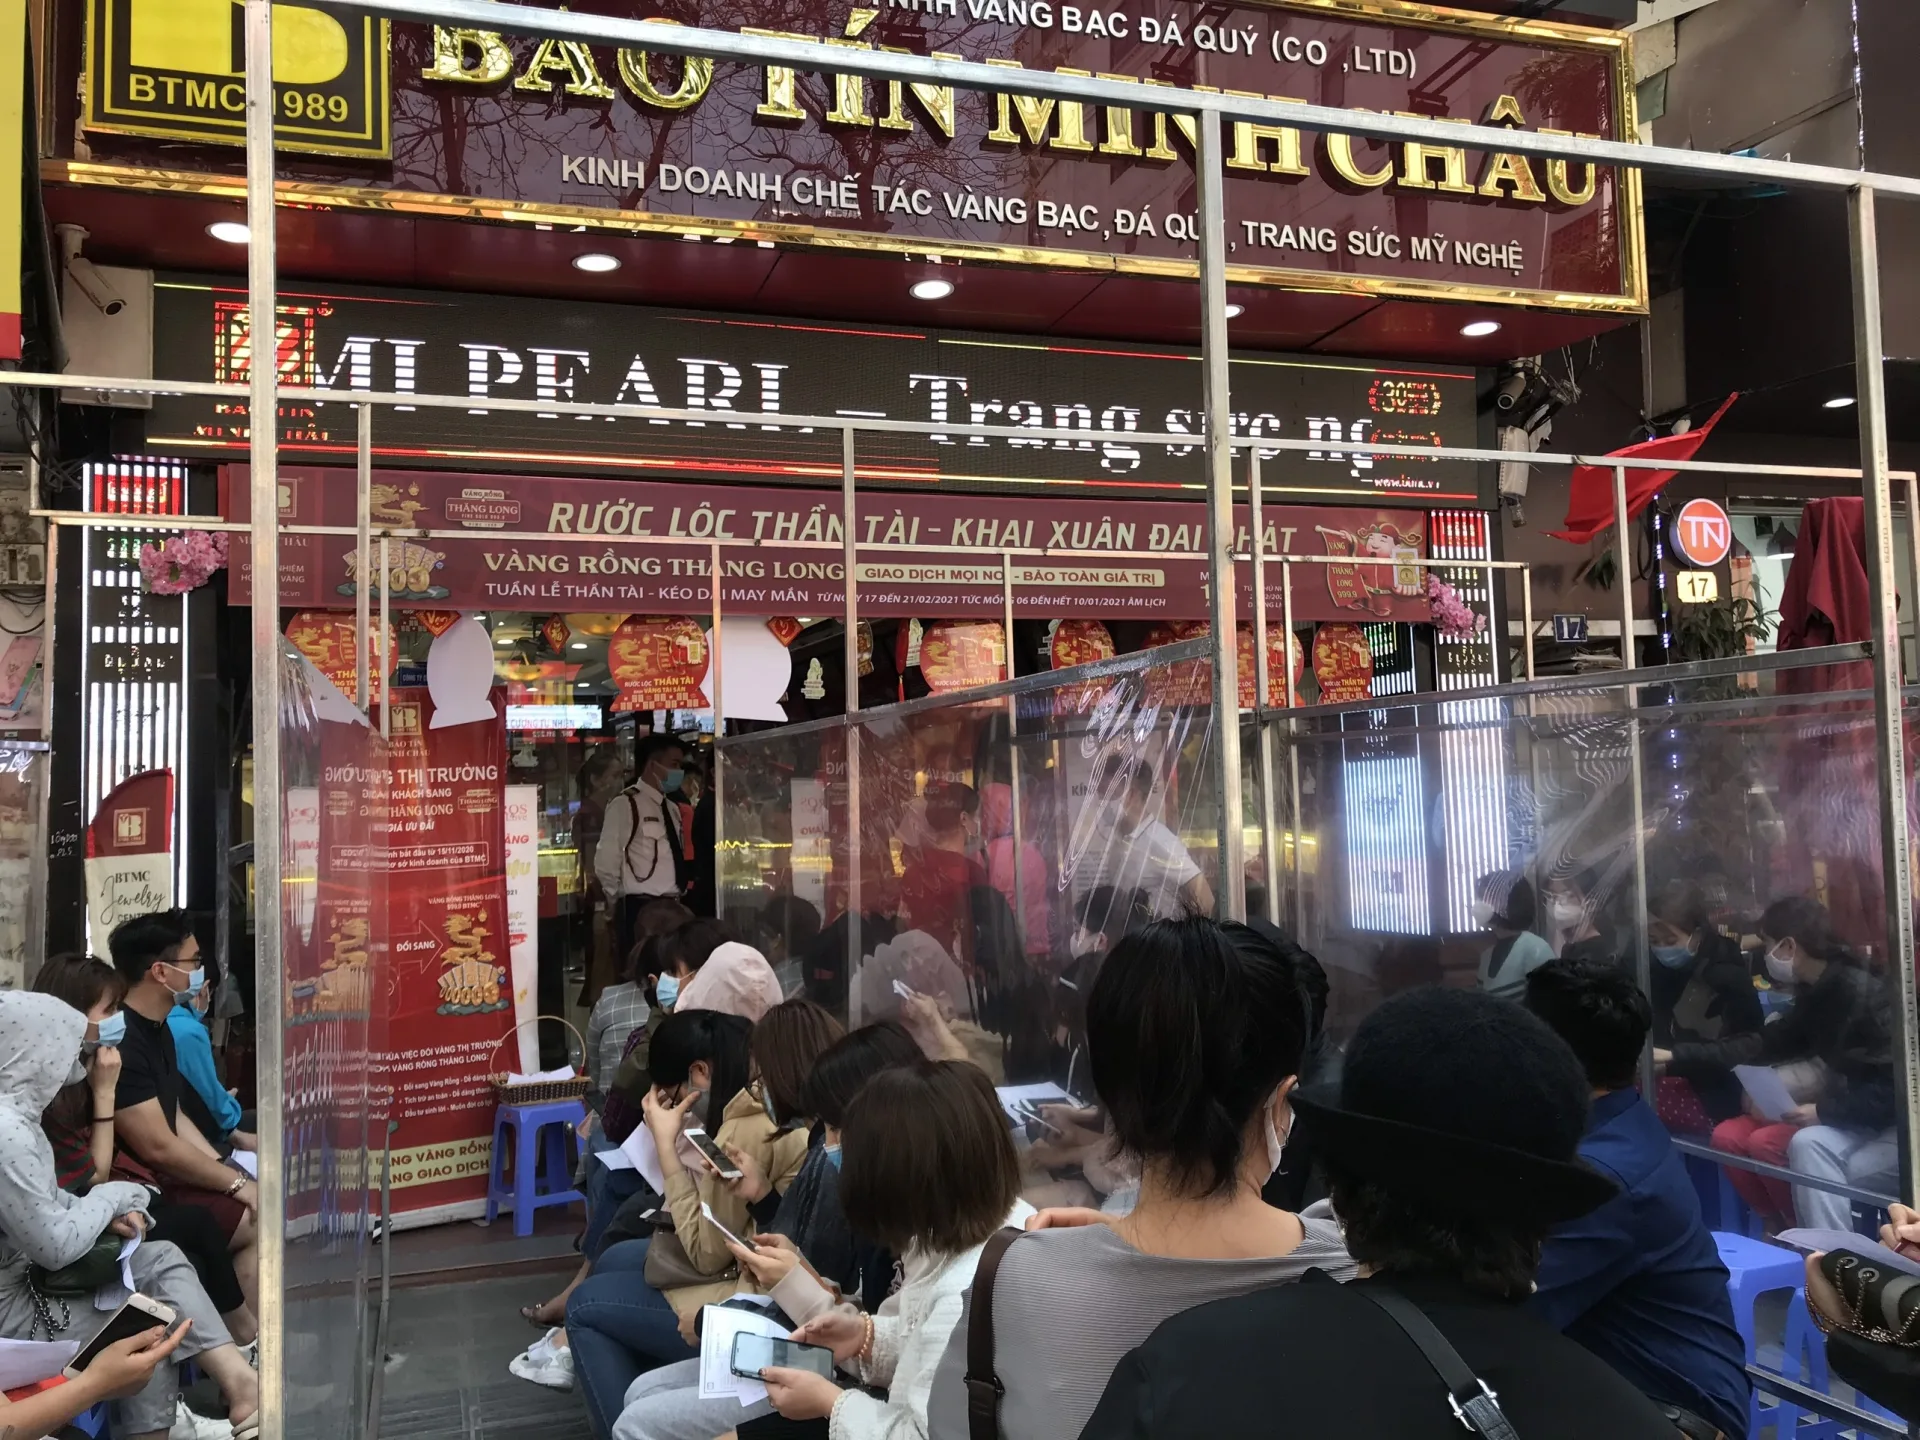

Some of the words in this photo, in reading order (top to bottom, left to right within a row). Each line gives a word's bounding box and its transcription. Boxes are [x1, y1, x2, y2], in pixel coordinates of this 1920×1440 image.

[1062, 5, 1129, 39] BẠC
[1139, 14, 1183, 49] ĐÁ
[1194, 19, 1257, 56] QUÝ
[129, 73, 246, 112] BTMC
[1327, 94, 1601, 205] CHÂU
[561, 154, 645, 189] KINH
[659, 163, 782, 203] DOANH
[792, 172, 862, 210] CHẾ
[870, 179, 932, 215] TÁC
[943, 185, 1027, 225] VÀNG
[1114, 204, 1157, 238] ĐÁ
[1242, 220, 1337, 253] TRANG
[1347, 222, 1402, 259] SỨC
[1411, 230, 1450, 262] MỸ
[1455, 238, 1524, 277] NGHỆ
[909, 374, 1141, 473] Trang
[447, 503, 486, 513] THĂNG
[489, 505, 518, 514] LONG
[547, 498, 654, 536] RƯỚC
[751, 504, 845, 542] THẦN
[863, 509, 921, 545] TÀI
[951, 517, 1034, 548] KHAI
[1047, 515, 1136, 550] XUÂN
[1233, 520, 1298, 553] HÁT
[1683, 515, 1726, 549] TN
[484, 548, 570, 573] VÀNG
[578, 548, 661, 575] RỒNG
[773, 561, 845, 581] LONG
[865, 567, 904, 580] GIAO
[908, 567, 946, 582] DỊCH
[950, 570, 979, 583] MỌI
[1023, 568, 1055, 582] BẢO
[1059, 569, 1099, 583] TOÀN
[1103, 570, 1129, 584] GIÁ
[1134, 572, 1156, 586] TRỊ
[1336, 579, 1353, 587] LONG
[485, 581, 536, 597] TUẦN
[541, 580, 561, 597] LỄ
[564, 583, 614, 600] THẦN
[617, 583, 644, 599] TÀI
[658, 586, 693, 600] KÉO
[731, 589, 766, 601] MAY
[771, 586, 809, 602] MẮN
[1687, 578, 1708, 597] 17
[817, 591, 832, 602] TỪ
[865, 593, 876, 603] 17
[878, 592, 901, 603] ĐẾN
[902, 594, 959, 605] 21/02/2021
[961, 594, 980, 605] TỨC
[1016, 596, 1029, 606] 06
[1030, 594, 1052, 606] ĐẾN
[1053, 594, 1073, 606] HẾT
[1073, 596, 1126, 607] 10/01/2021
[1127, 596, 1144, 607] ÂM
[1145, 597, 1166, 609] LỊCH
[1561, 617, 1581, 639] 17
[654, 676, 679, 686] THẦN
[680, 676, 694, 685] TÀI
[397, 768, 424, 787] THỊ
[427, 763, 498, 783] TRƯỜNG
[392, 787, 424, 800] KHÁCH
[425, 787, 452, 799] SANG
[424, 803, 453, 816] LONG
[115, 870, 150, 884] BTMC
[100, 875, 166, 925] Jewelry
[396, 941, 411, 952] ĐỔI
[412, 940, 435, 951] SANG
[416, 1148, 455, 1162] VÀNG
[417, 1165, 452, 1179] GIAO
[456, 1159, 489, 1174] DỊCH
